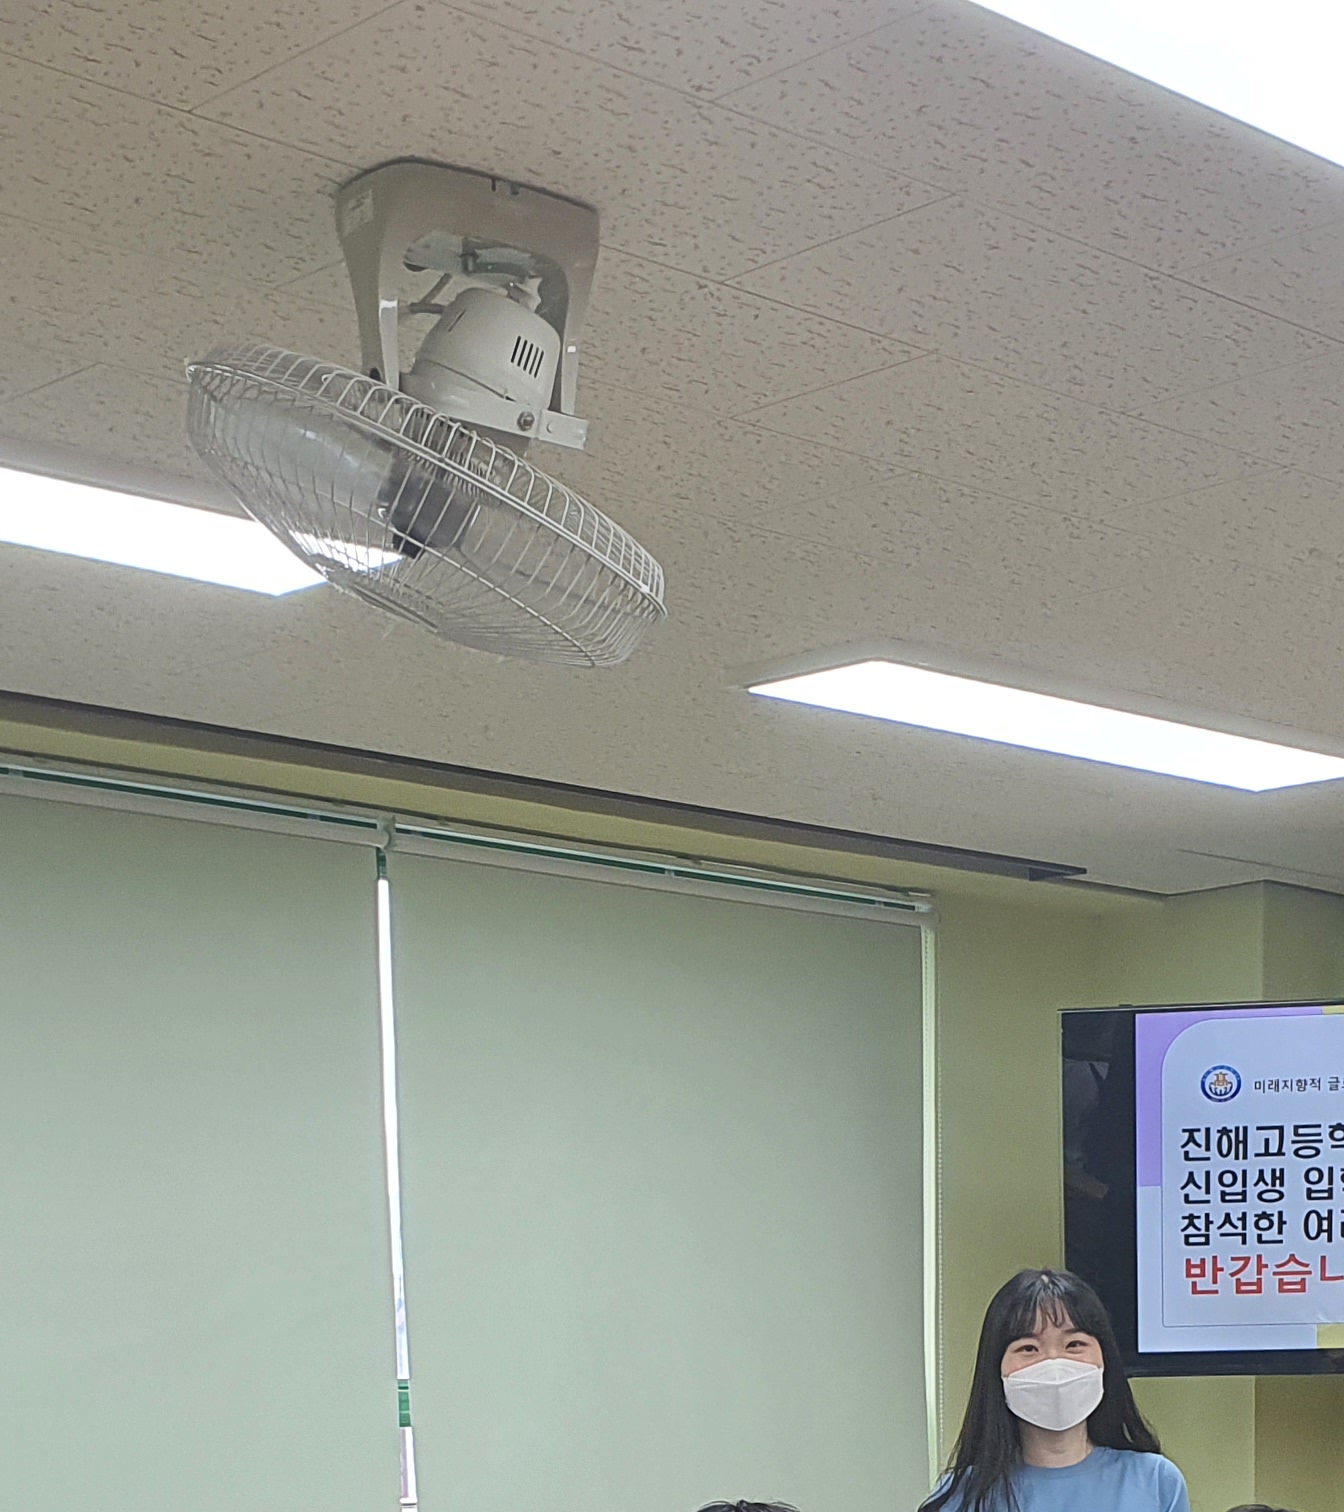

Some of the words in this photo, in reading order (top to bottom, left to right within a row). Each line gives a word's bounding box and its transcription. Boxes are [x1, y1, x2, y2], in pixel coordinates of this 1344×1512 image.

[1254, 1077, 1321, 1094] 미래지향적
[1179, 1165, 1285, 1206] 신입생
[1179, 1210, 1286, 1247] 참석한
